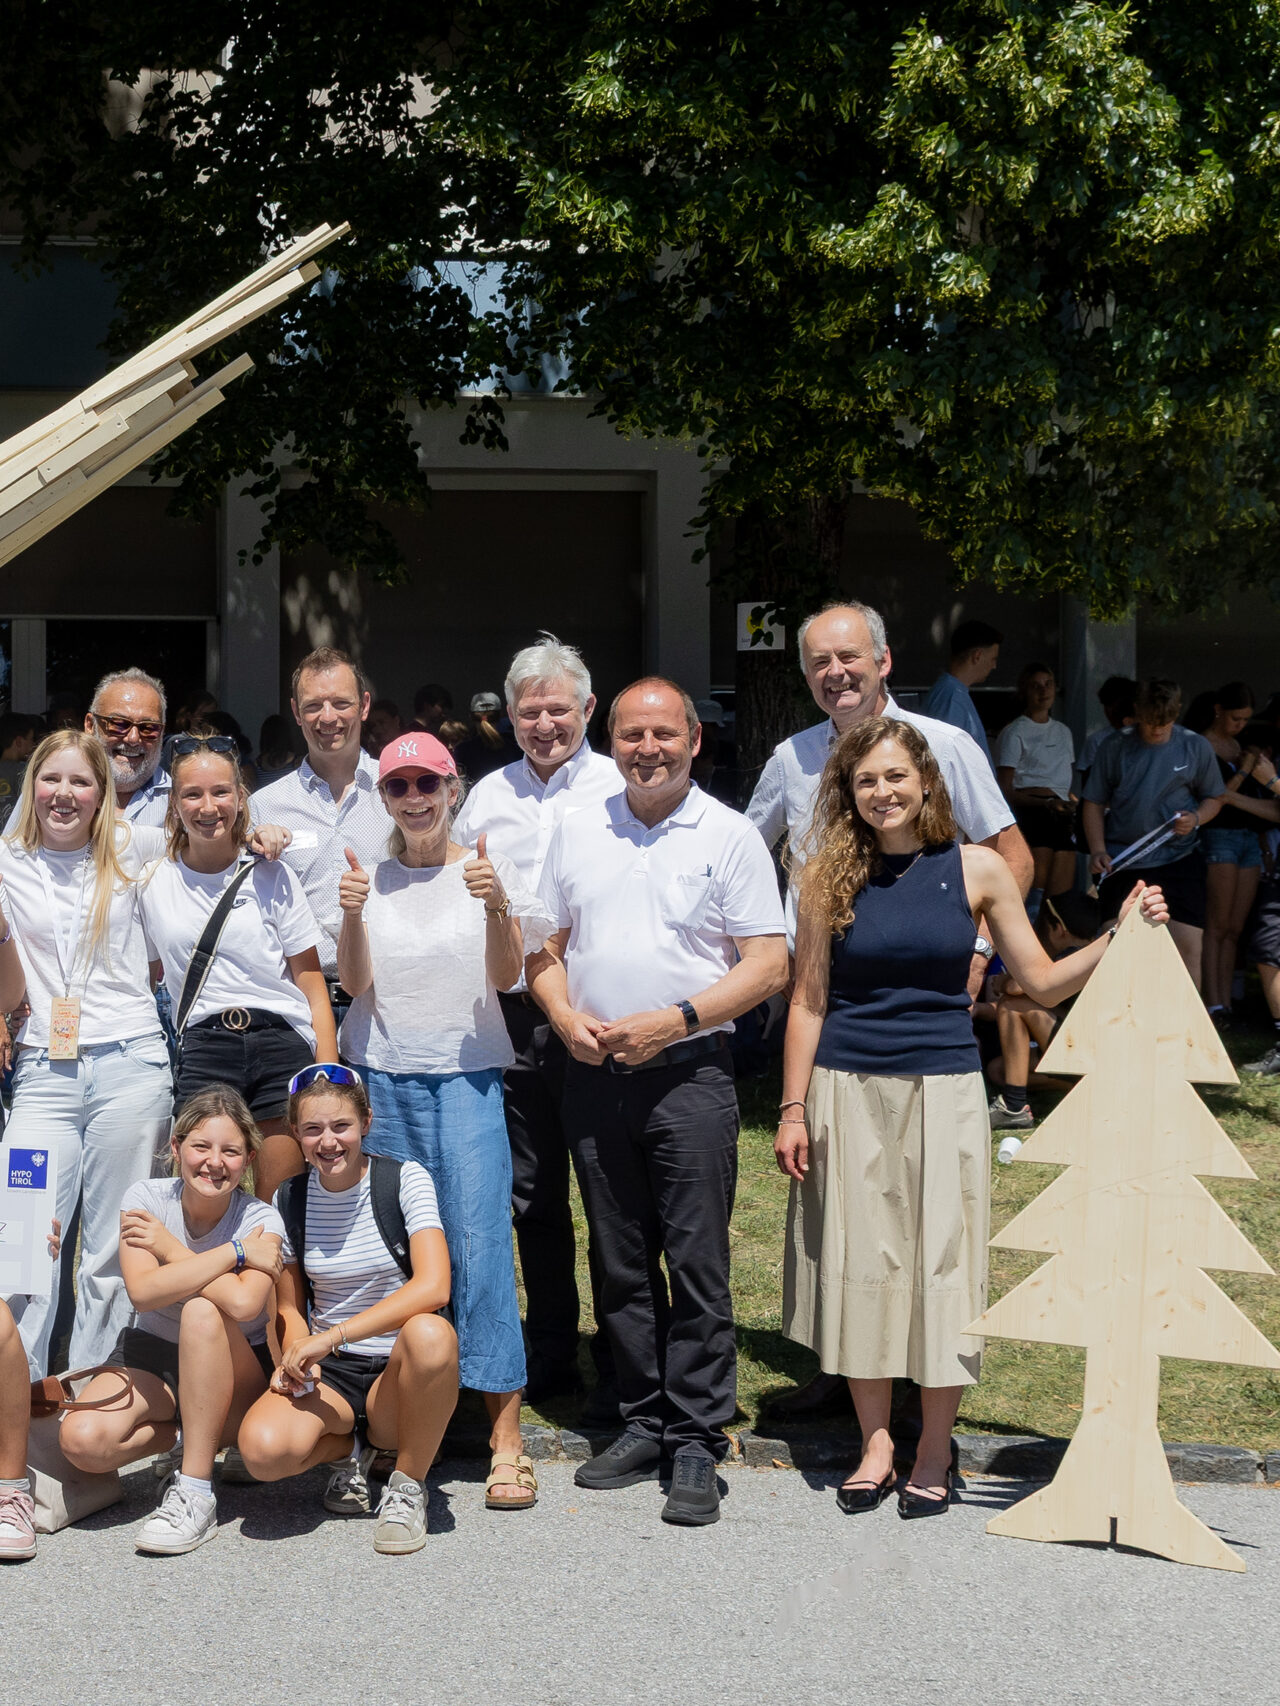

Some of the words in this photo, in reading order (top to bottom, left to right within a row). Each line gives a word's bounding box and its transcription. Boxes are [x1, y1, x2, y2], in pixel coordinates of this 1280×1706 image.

[398, 740, 418, 758] NY
[11, 1170, 32, 1178] HYPO
[11, 1177, 33, 1186] TIROL
